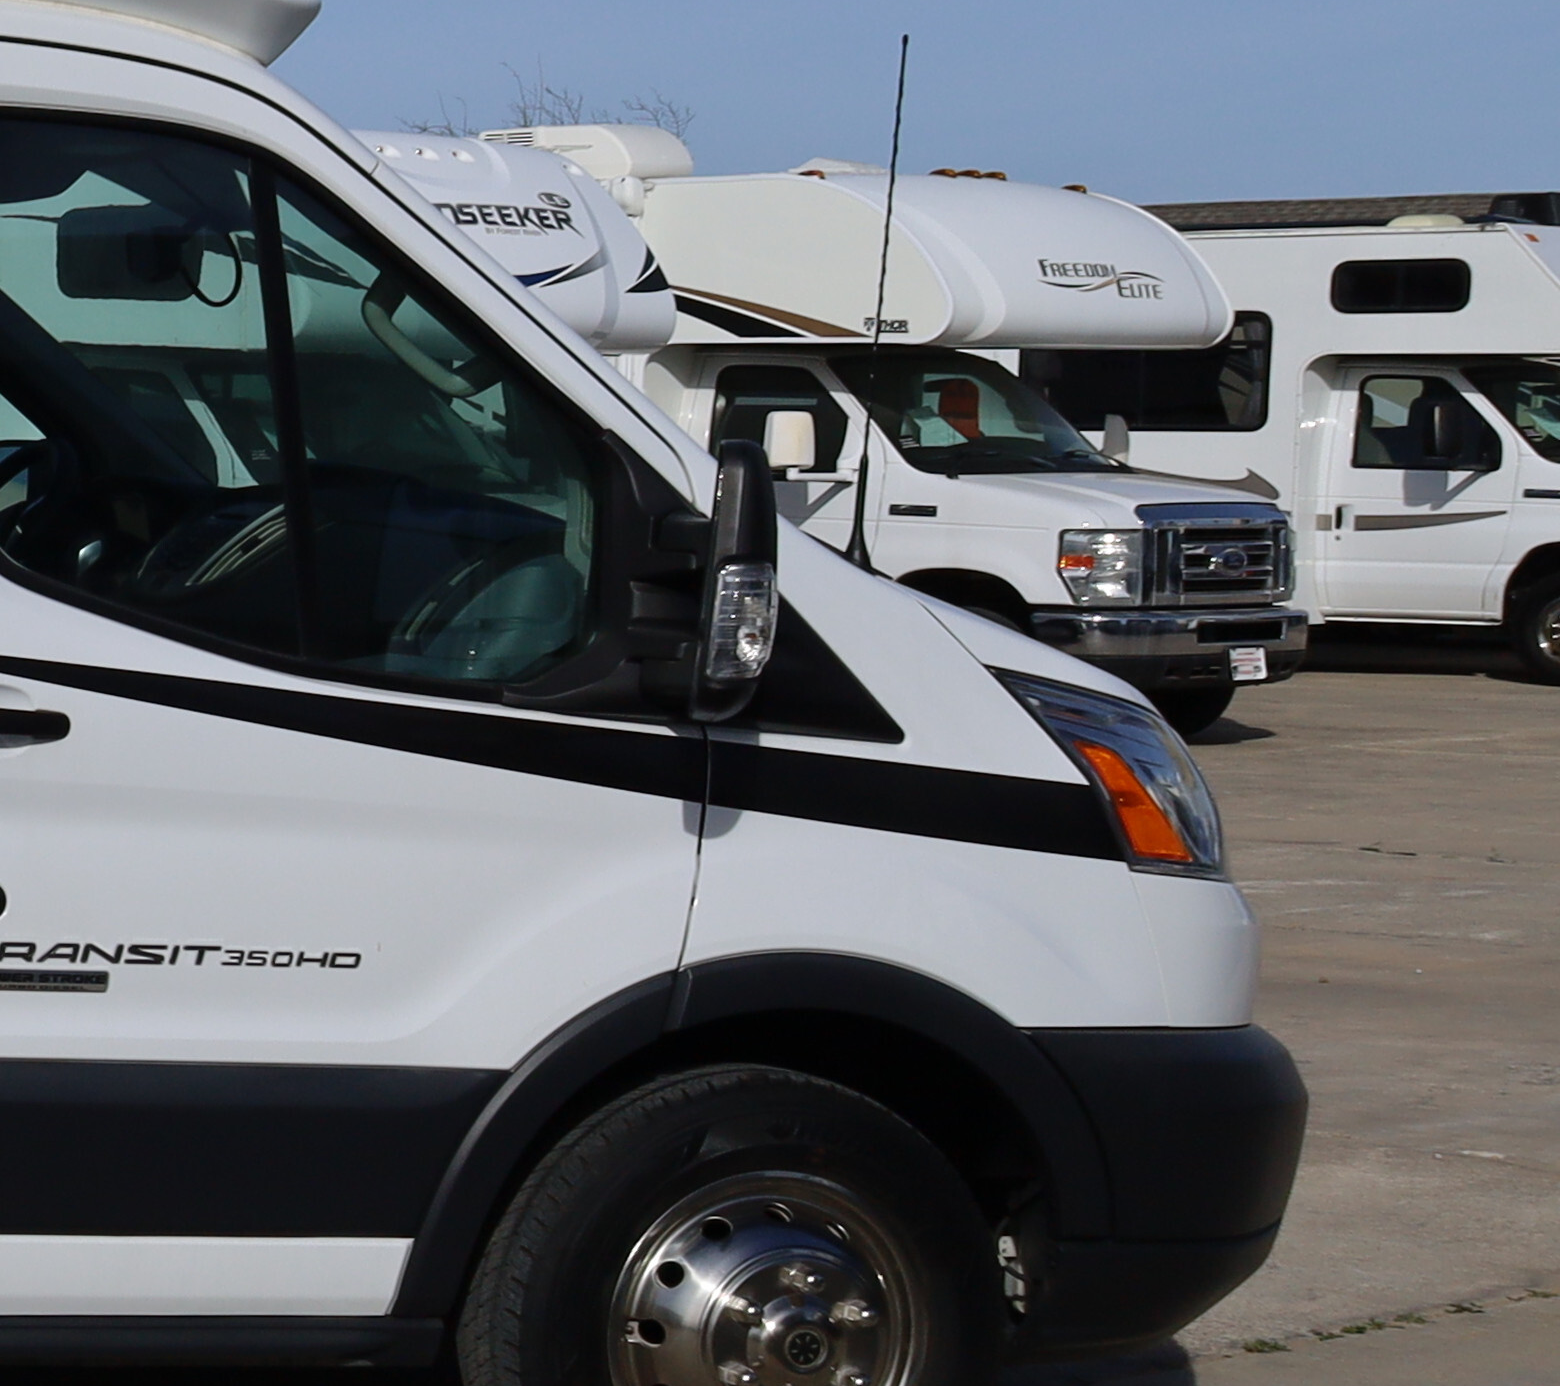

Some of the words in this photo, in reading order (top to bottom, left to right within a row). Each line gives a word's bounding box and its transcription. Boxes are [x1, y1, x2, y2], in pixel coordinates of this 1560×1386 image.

[1037, 259, 1117, 278] FREEDOM
[1116, 277, 1164, 300] ELITE
[221, 950, 361, 969] 350HD
[39, 973, 107, 984] STROKE
